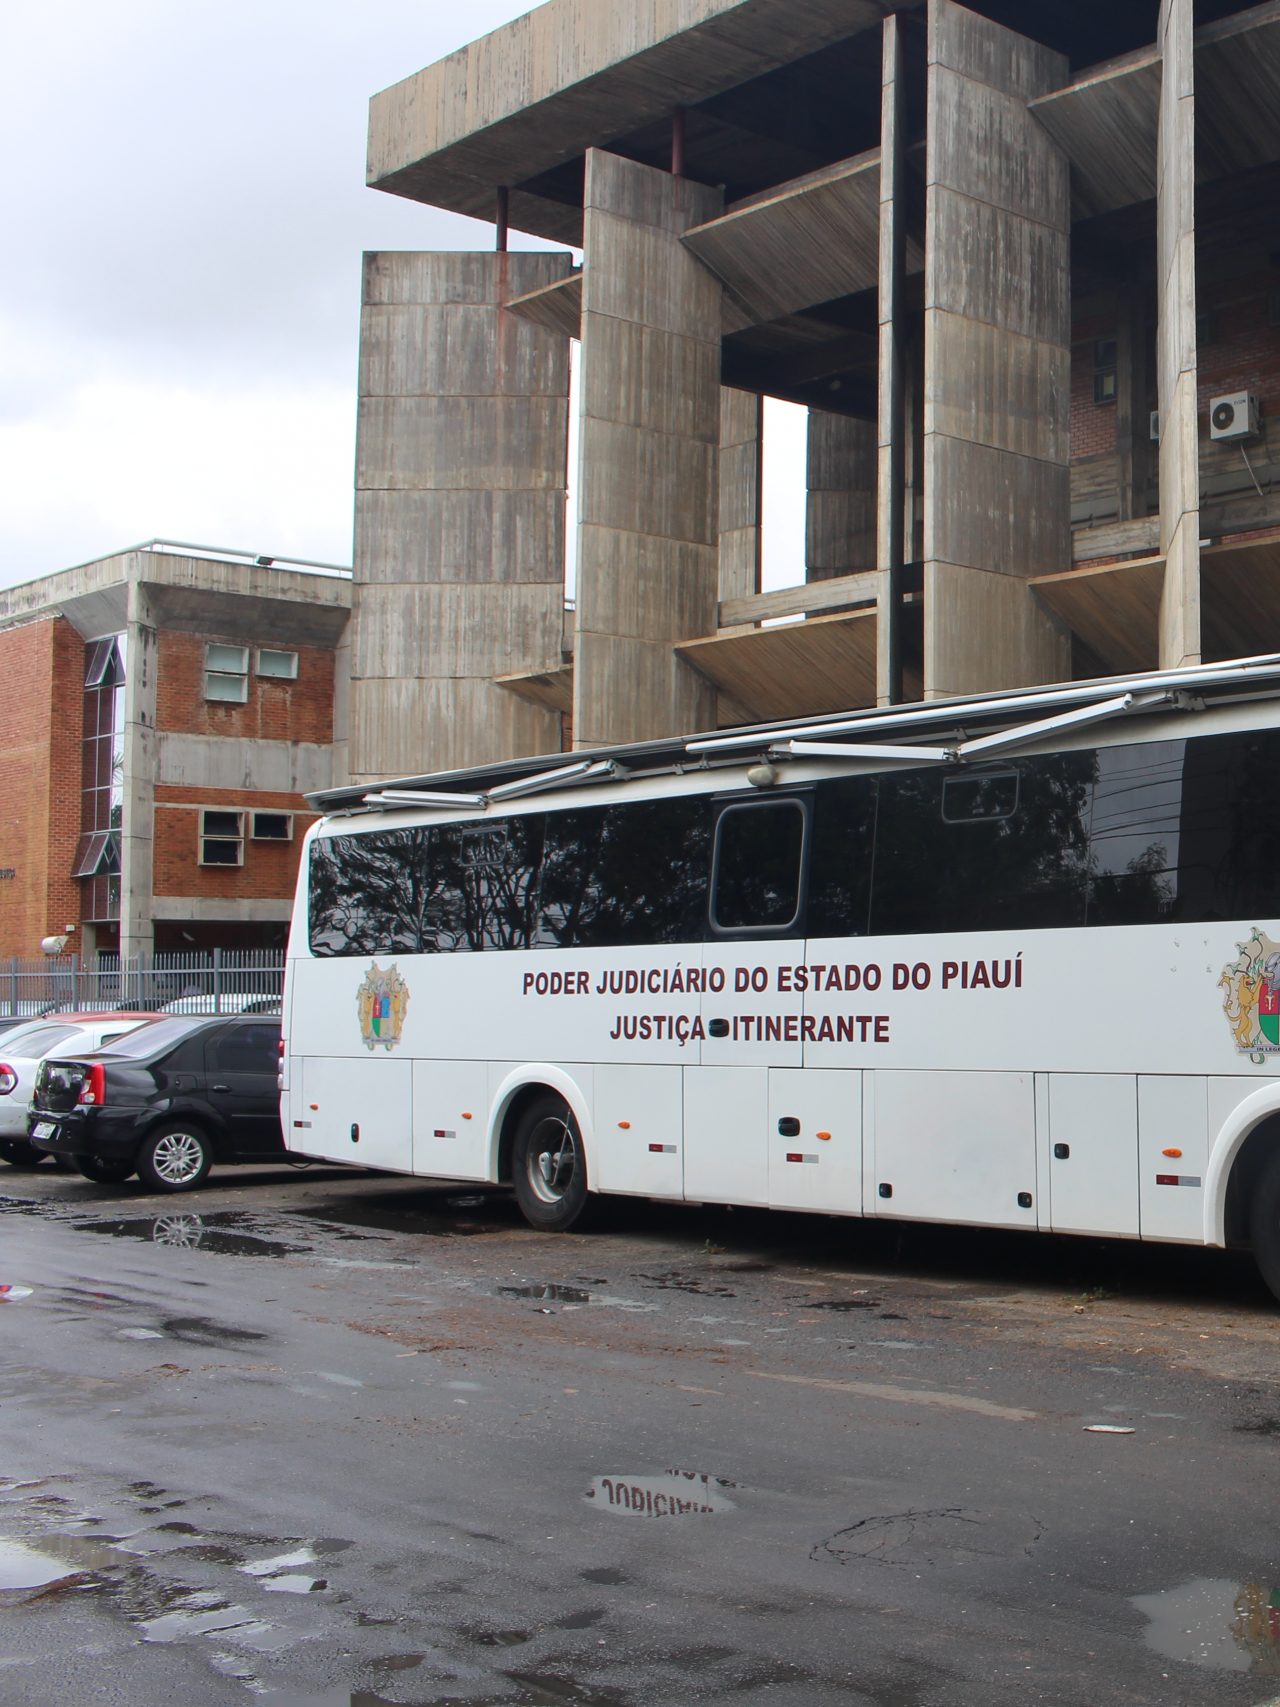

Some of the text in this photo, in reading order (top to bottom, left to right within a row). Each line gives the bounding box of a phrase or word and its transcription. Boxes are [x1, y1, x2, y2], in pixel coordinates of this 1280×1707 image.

[523, 951, 1023, 995] PODER JUDICIÁRIO DO ESTADO DO PIAUÍ
[610, 1015, 890, 1046] JUSTIÇA ITINERANTE
